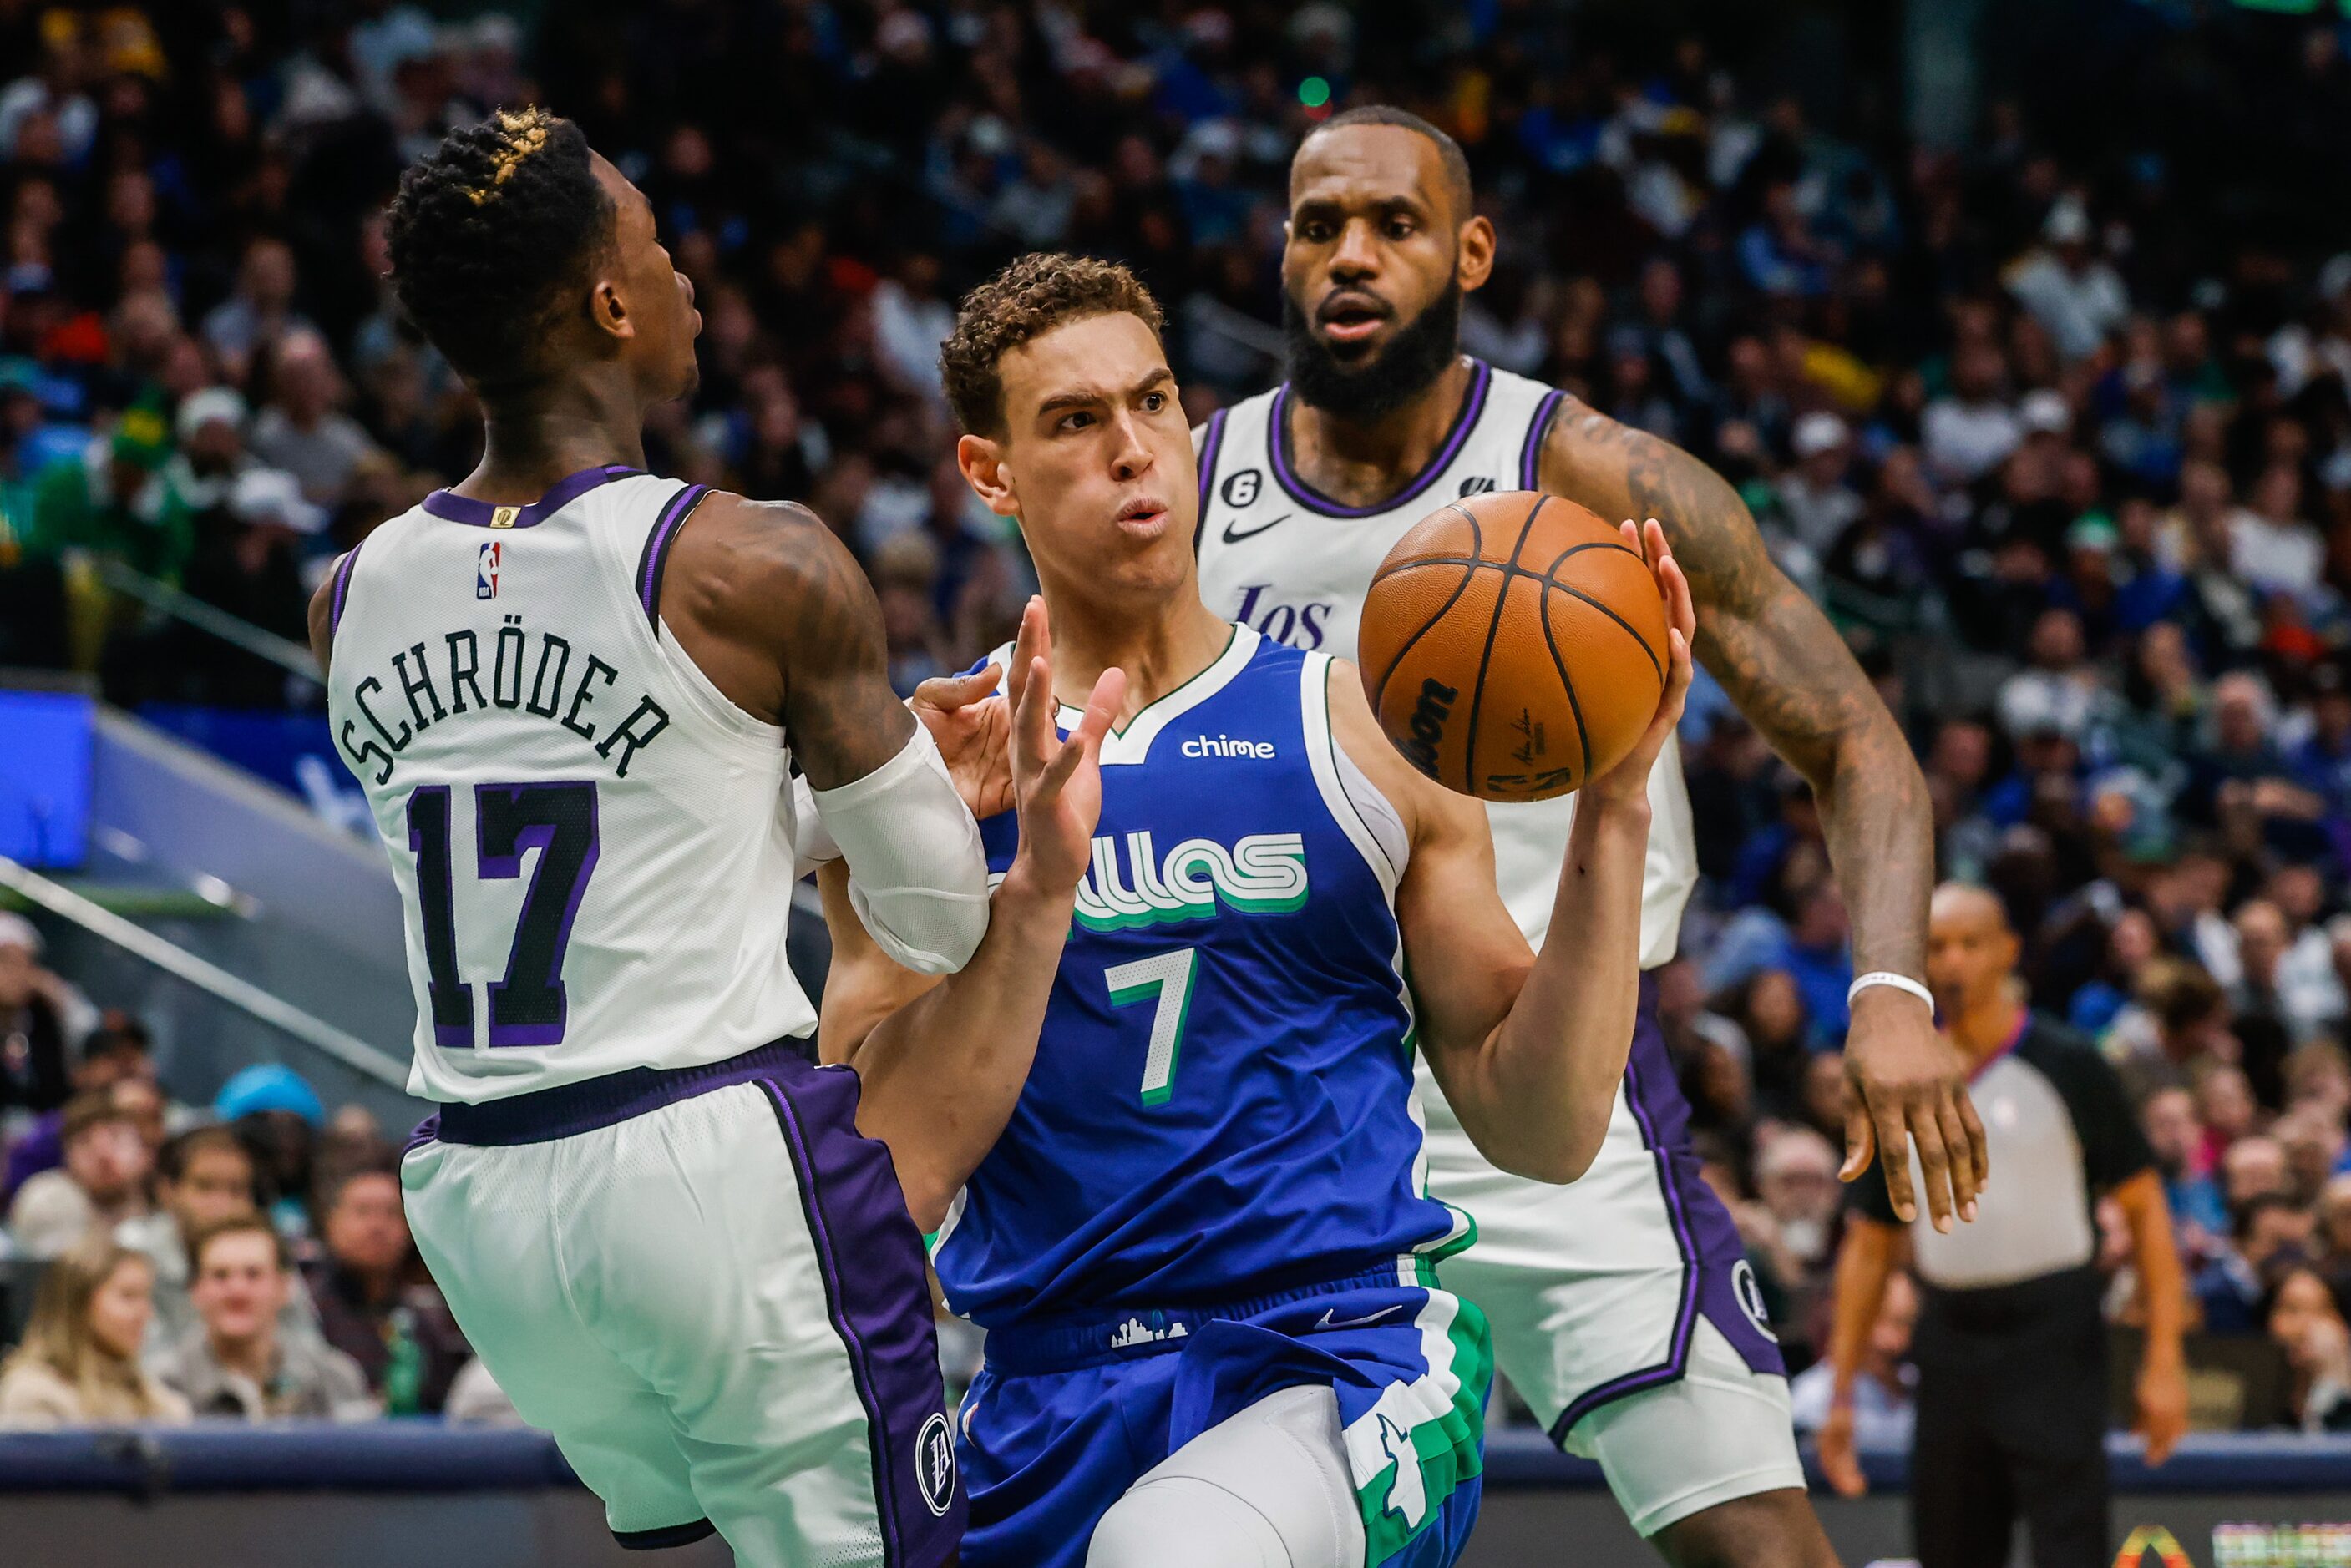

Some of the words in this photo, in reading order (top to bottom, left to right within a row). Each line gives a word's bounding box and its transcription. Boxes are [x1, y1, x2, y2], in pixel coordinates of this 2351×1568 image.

[1225, 470, 1259, 507] 6
[342, 616, 669, 784] SCHRÖDER
[1181, 734, 1275, 759] chime
[407, 782, 600, 1046] 17
[1104, 947, 1198, 1108] 7
